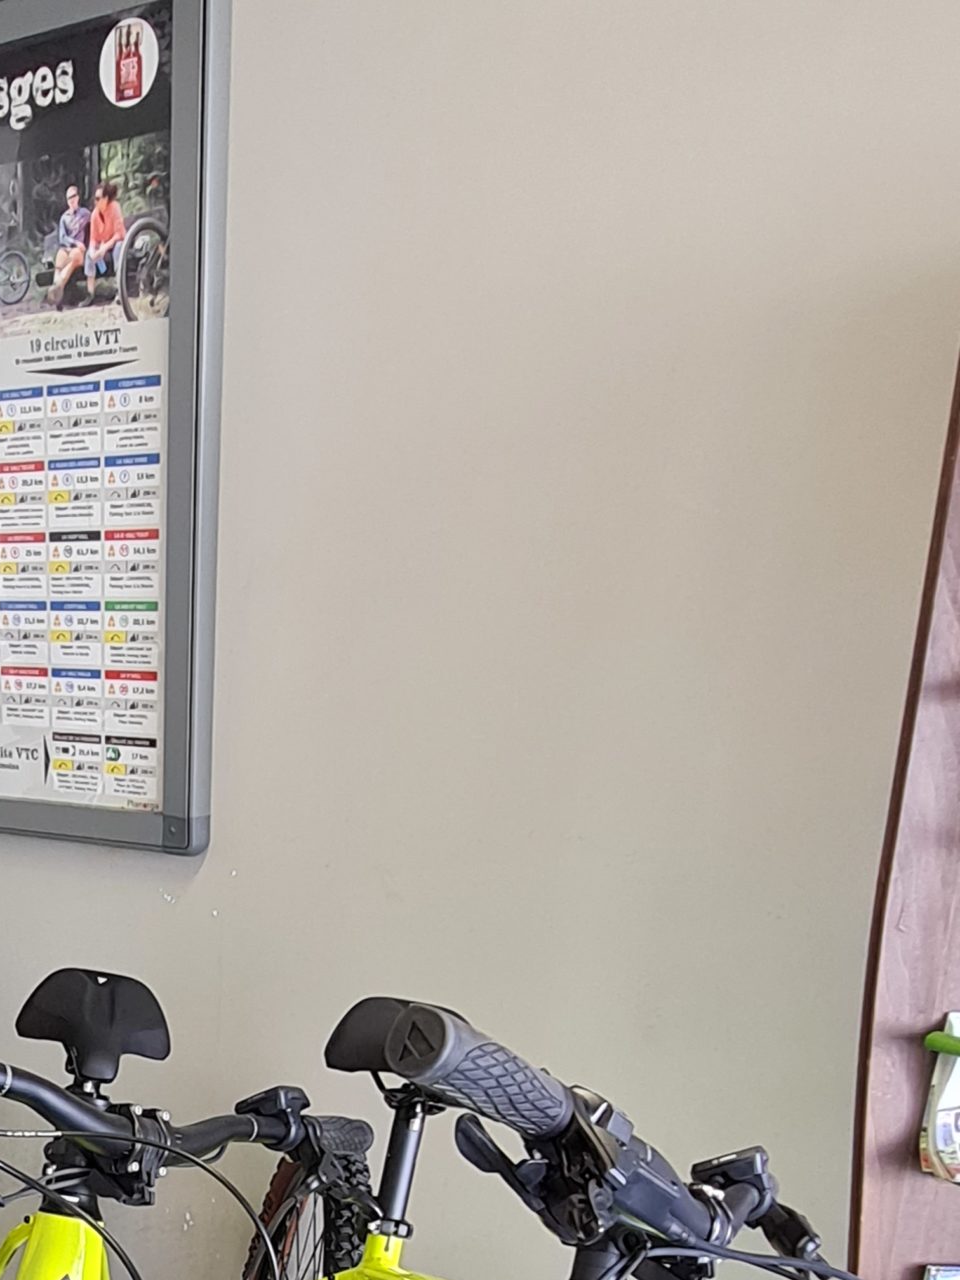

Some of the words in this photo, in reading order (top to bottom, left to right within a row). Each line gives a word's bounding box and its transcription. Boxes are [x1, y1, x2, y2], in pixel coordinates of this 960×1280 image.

[30, 338, 42, 354] 19
[44, 333, 90, 353] circuits
[94, 328, 122, 345] VTT
[15, 746, 39, 761] VTC
